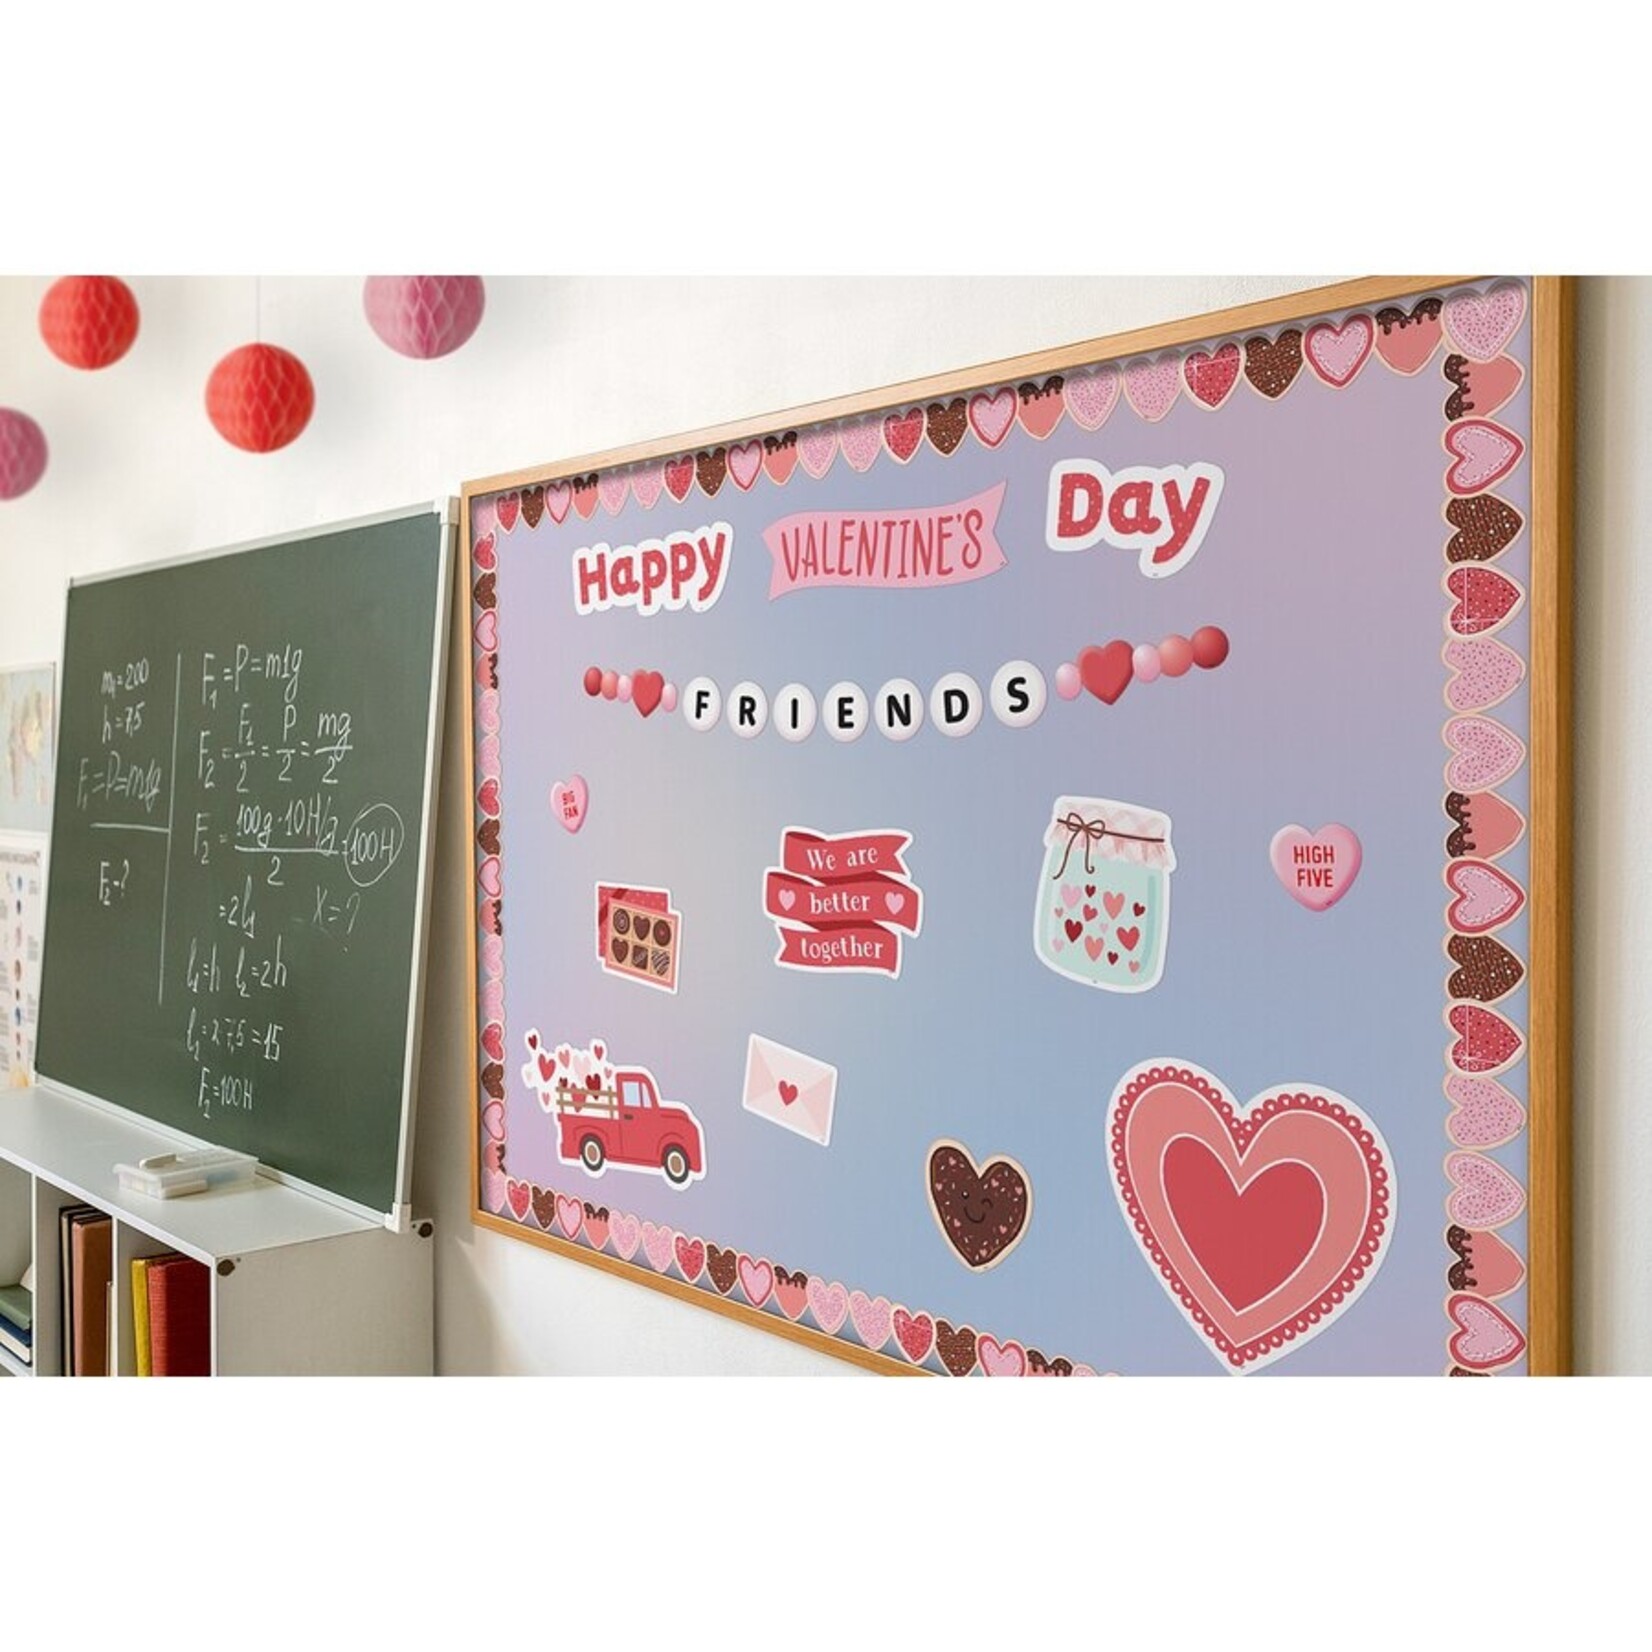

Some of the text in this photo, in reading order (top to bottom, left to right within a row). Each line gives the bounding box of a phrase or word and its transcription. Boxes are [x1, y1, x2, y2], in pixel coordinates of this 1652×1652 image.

[578, 472, 1210, 606] Happy VALENTINE'S Day
[695, 676, 1029, 731] FRIENDS
[806, 847, 879, 872] We are
[1293, 845, 1335, 864] HIGH
[1297, 868, 1334, 888] FIVE
[809, 891, 871, 915] better
[801, 935, 884, 964] together
